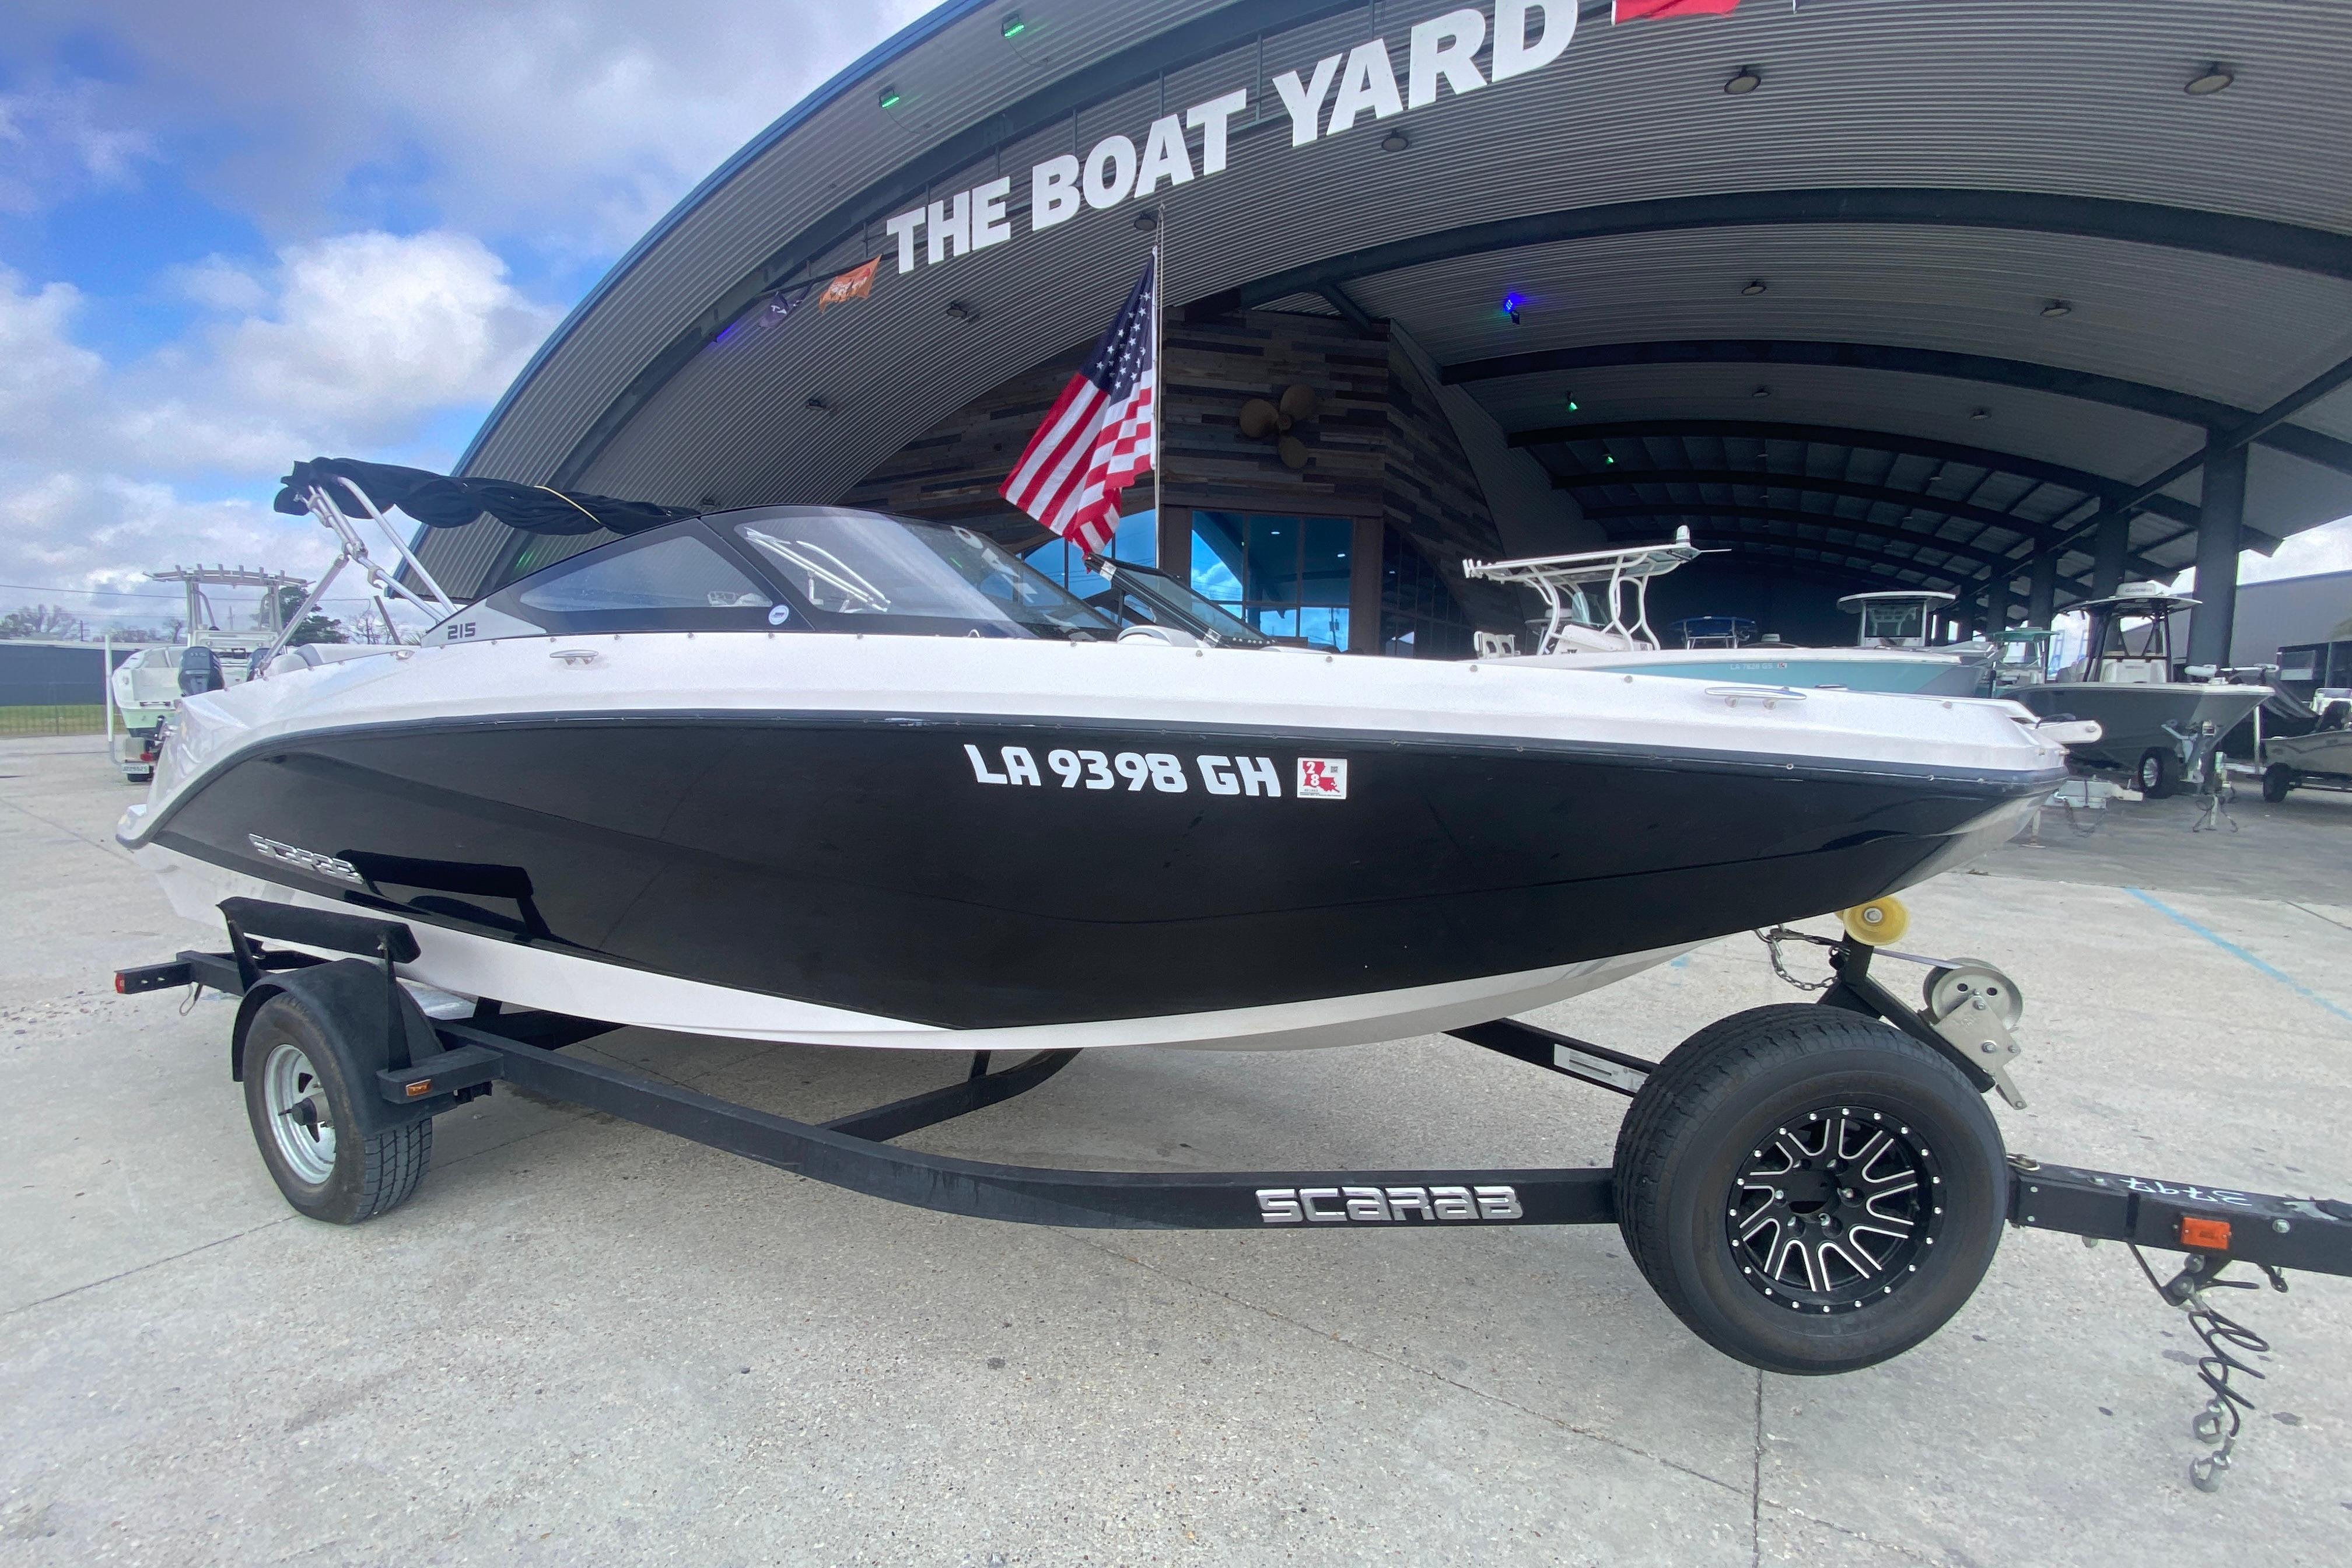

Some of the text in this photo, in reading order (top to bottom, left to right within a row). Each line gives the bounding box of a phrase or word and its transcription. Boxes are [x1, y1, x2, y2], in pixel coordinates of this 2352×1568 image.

[886, 0, 1578, 274] THE BOAT YARD
[447, 622, 476, 640] 215
[963, 744, 1282, 797] LA 9398 GH
